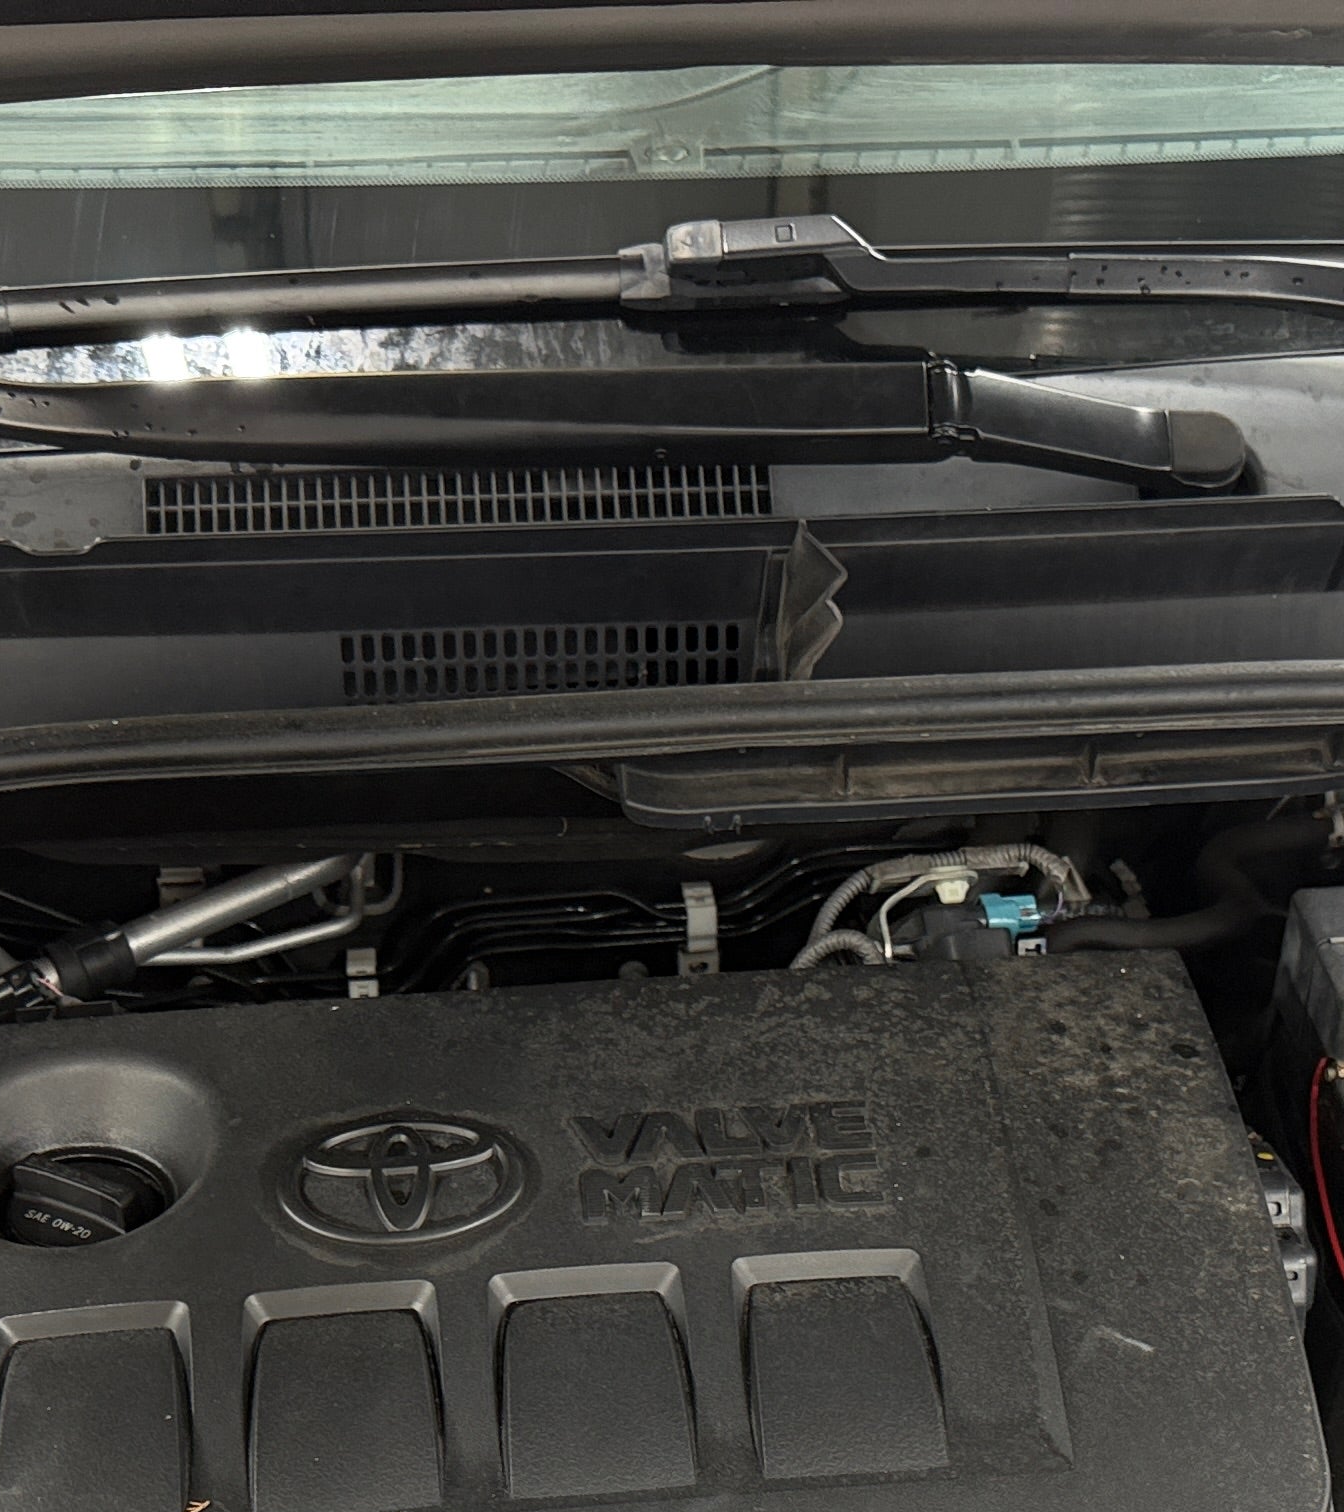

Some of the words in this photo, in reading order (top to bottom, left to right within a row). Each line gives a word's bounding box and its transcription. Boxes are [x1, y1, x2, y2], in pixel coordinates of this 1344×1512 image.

[567, 1100, 874, 1166] VALVE
[578, 1153, 890, 1225] MATIC
[24, 1209, 52, 1224] SAE
[51, 1218, 93, 1239] 0W-20
